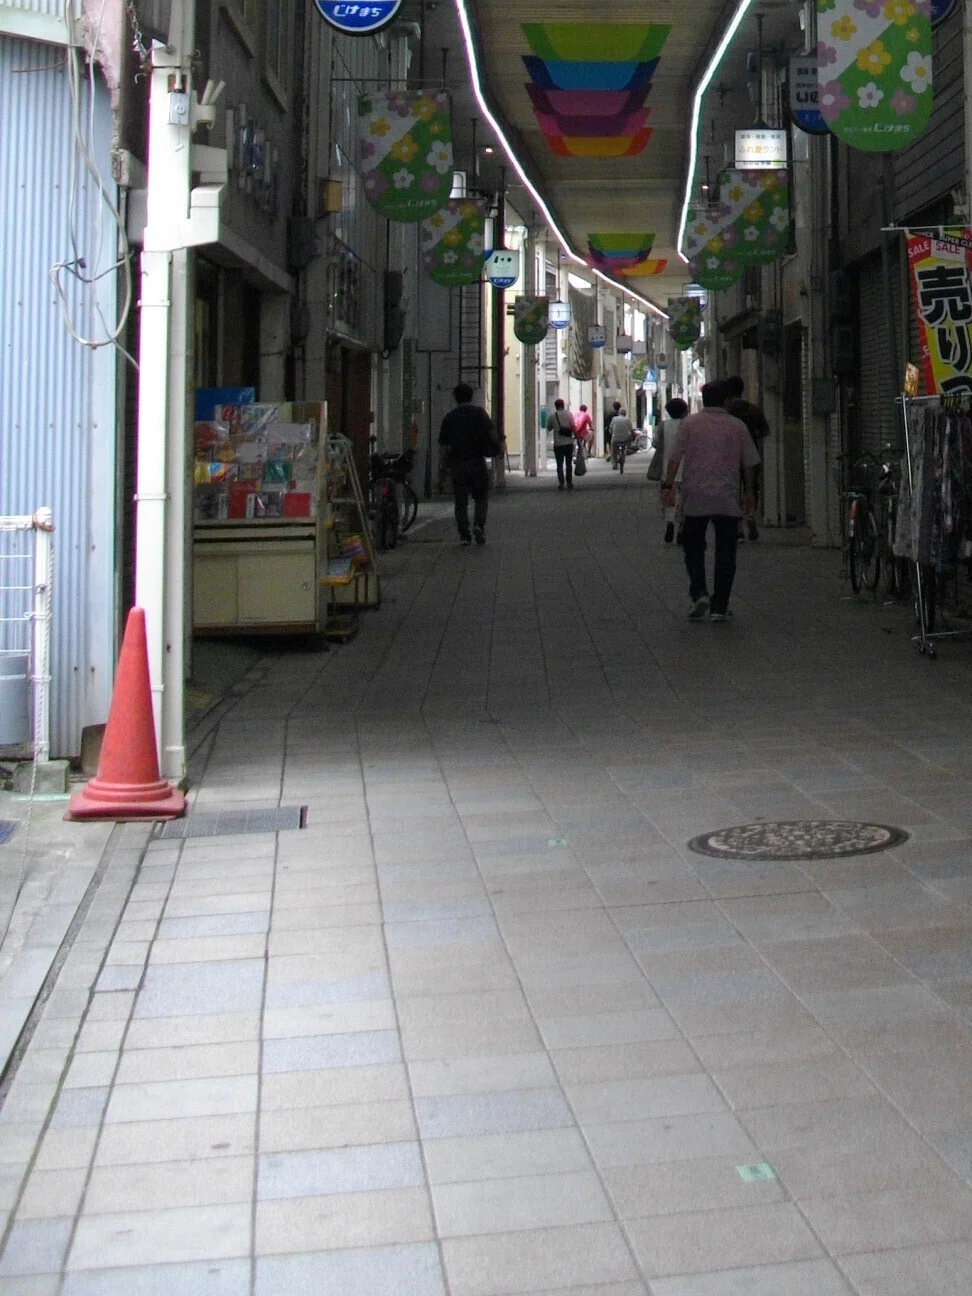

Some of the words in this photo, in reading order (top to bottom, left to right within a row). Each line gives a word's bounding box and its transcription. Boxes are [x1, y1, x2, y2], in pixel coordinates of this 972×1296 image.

[333, 4, 382, 17] じけまち
[908, 241, 930, 258] SALE
[935, 241, 961, 254] SALE
